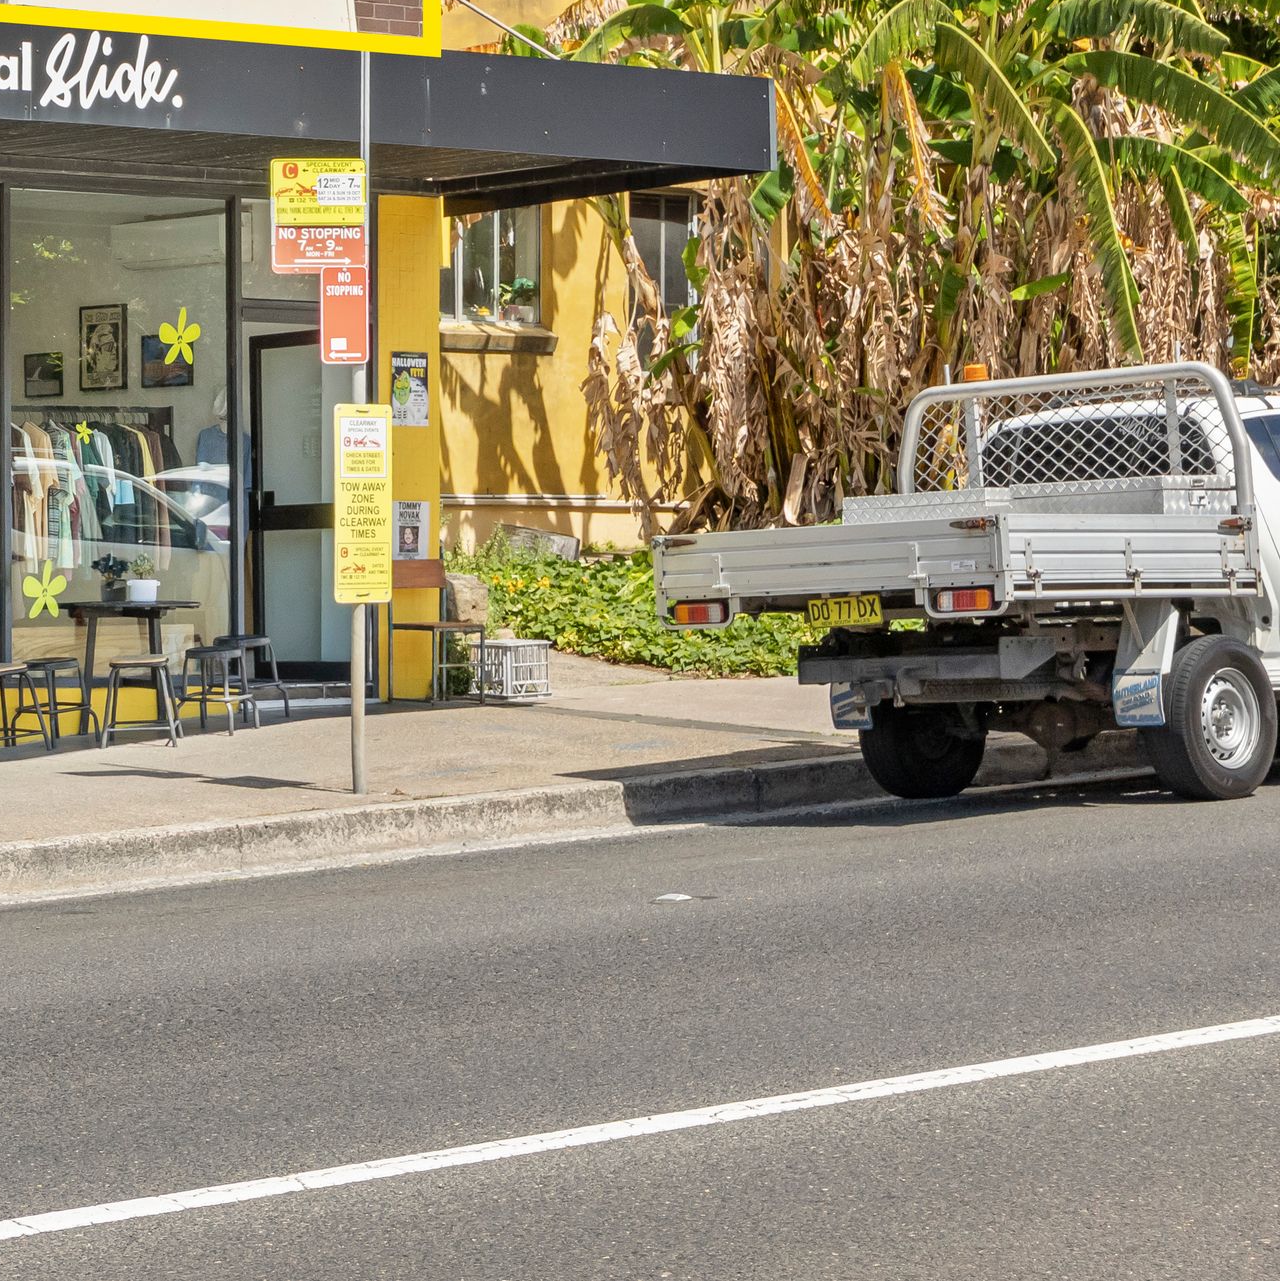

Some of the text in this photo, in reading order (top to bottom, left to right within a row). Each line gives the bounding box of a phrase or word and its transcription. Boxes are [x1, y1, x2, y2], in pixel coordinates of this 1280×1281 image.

[40, 30, 183, 110] Slide.
[318, 178, 329, 188] 12
[278, 227, 361, 239] NO STOPPING
[337, 272, 351, 282] NO
[326, 285, 364, 296] STOPPING
[392, 357, 427, 367] HALLOWEEN
[340, 482, 386, 492] TOW AWAY
[352, 494, 375, 503] ZONE
[347, 506, 380, 515] DURING
[398, 502, 421, 510] TOMMY
[399, 511, 420, 519] NOVAK
[340, 517, 387, 527] CLEARWAY
[350, 529, 376, 538] TIMES
